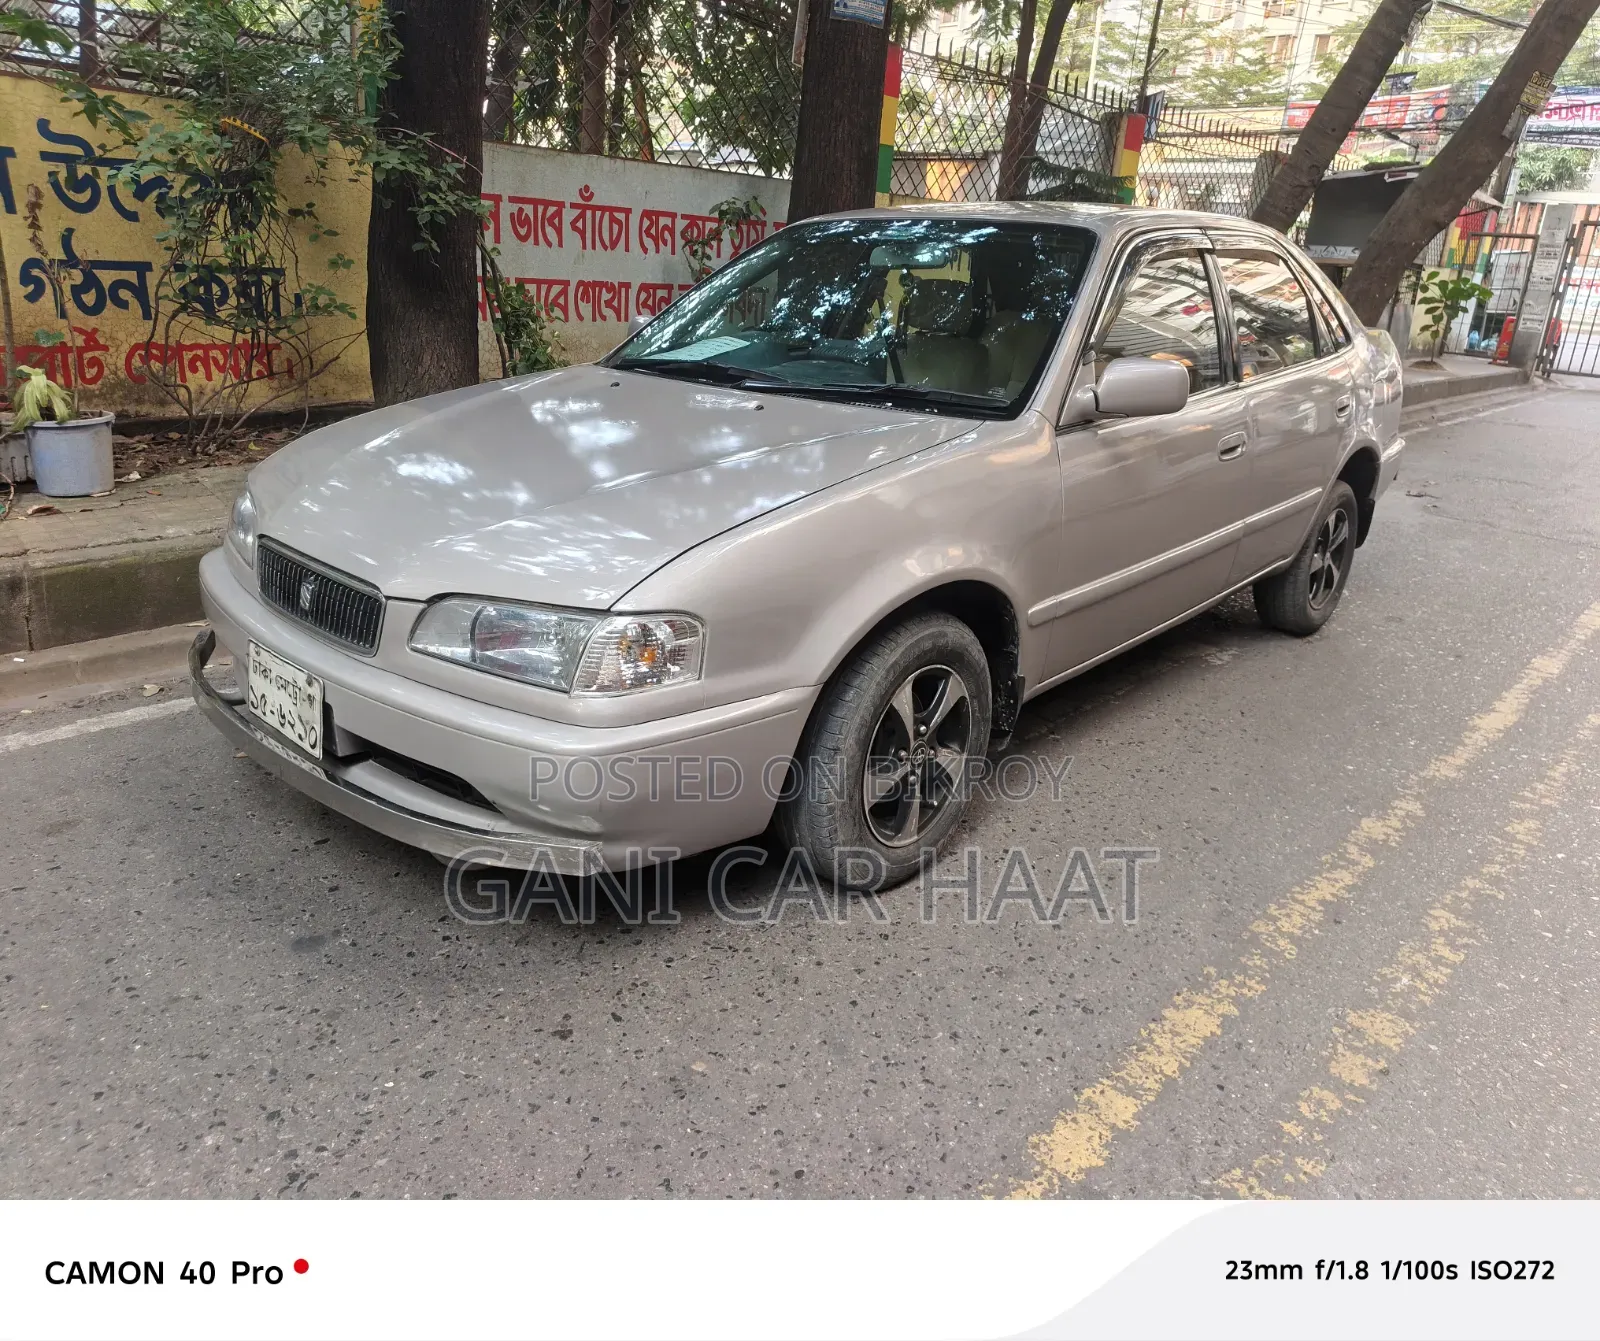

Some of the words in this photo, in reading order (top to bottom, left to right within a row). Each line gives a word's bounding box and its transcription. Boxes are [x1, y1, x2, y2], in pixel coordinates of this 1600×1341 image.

[507, 195, 566, 249] ভাবে
[569, 184, 633, 253] বাঁচো
[638, 209, 678, 256] যেন
[680, 213, 724, 259] কাল
[20, 227, 154, 321] গঠন
[514, 276, 571, 324] াবে
[573, 279, 632, 323] শেখো
[635, 282, 675, 317] যেন
